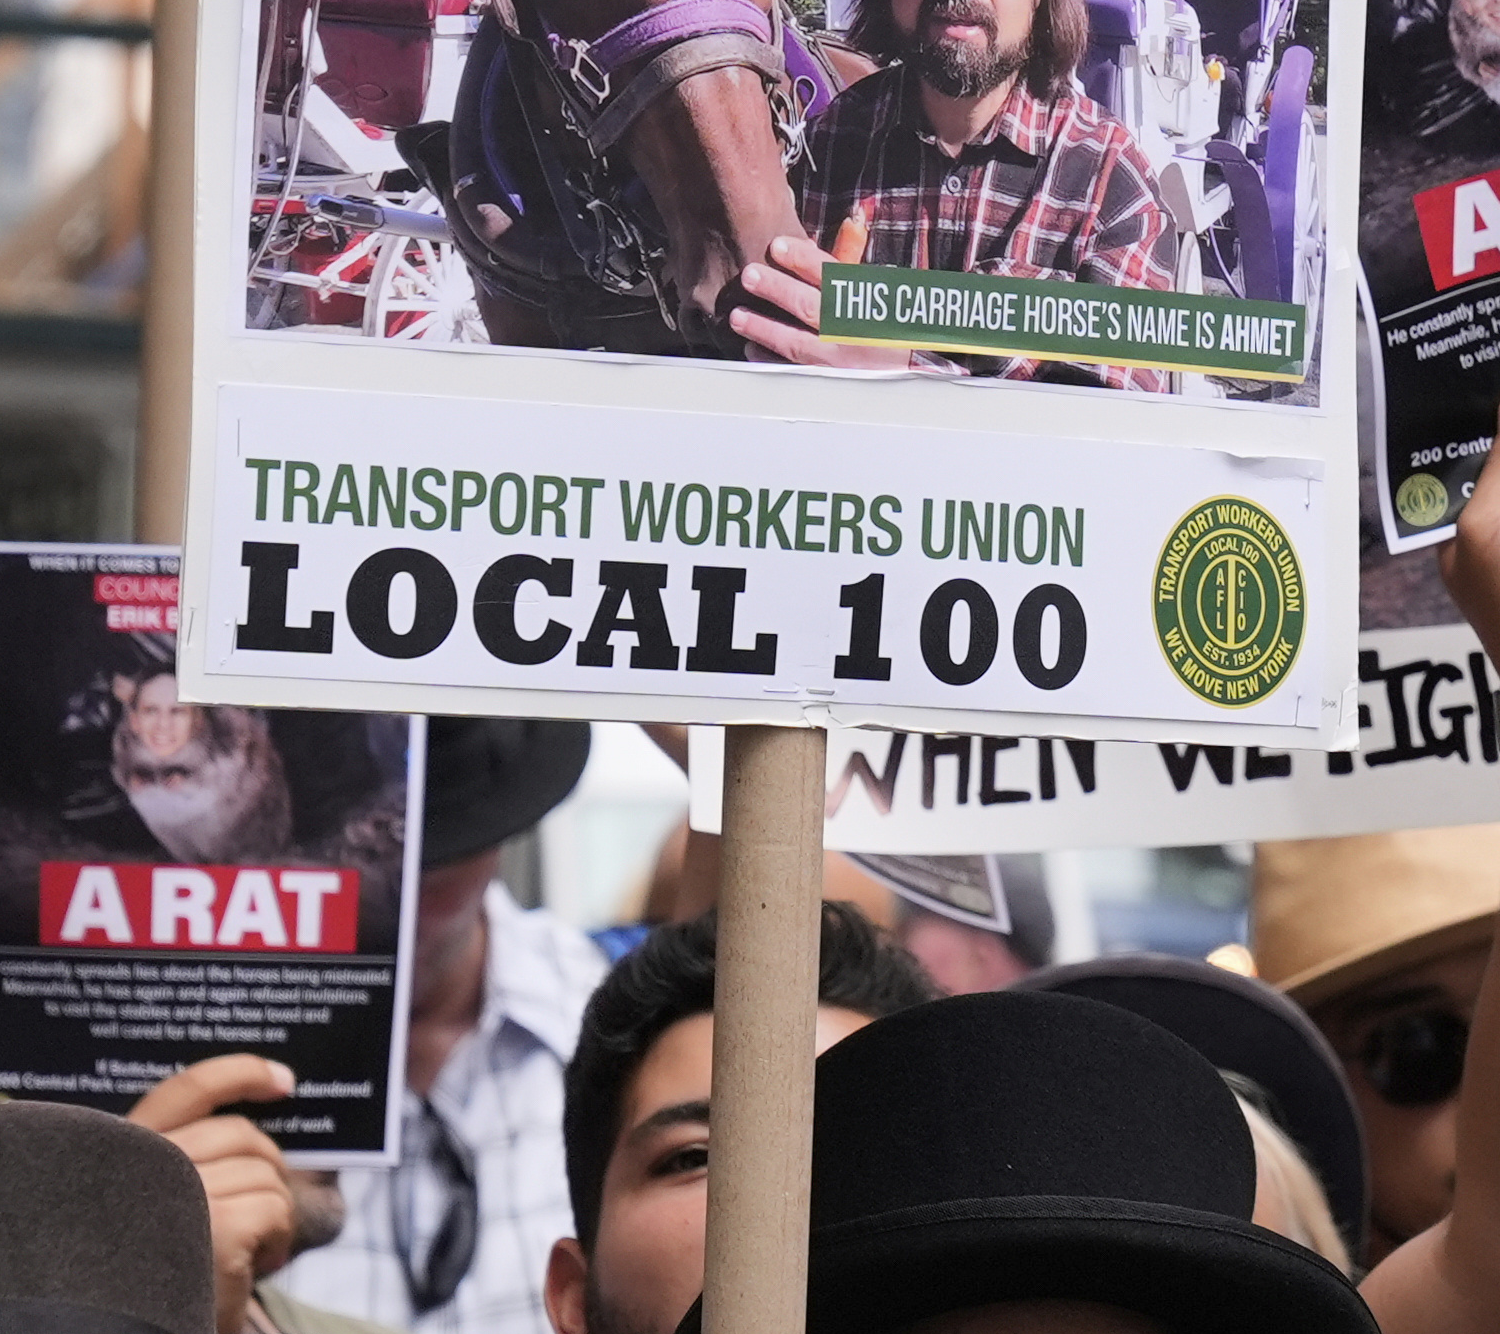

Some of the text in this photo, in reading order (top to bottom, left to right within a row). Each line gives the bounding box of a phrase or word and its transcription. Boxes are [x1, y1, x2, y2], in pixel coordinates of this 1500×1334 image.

[831, 279, 1296, 357] THIS CARRIAGE HORSE'S NAME IS AHMET
[1409, 303, 1474, 339] constantly
[245, 457, 1085, 568] TRANSPORT WORKERS UNION
[235, 541, 1088, 691] LOCAL 100
[60, 866, 341, 948] A RAT
